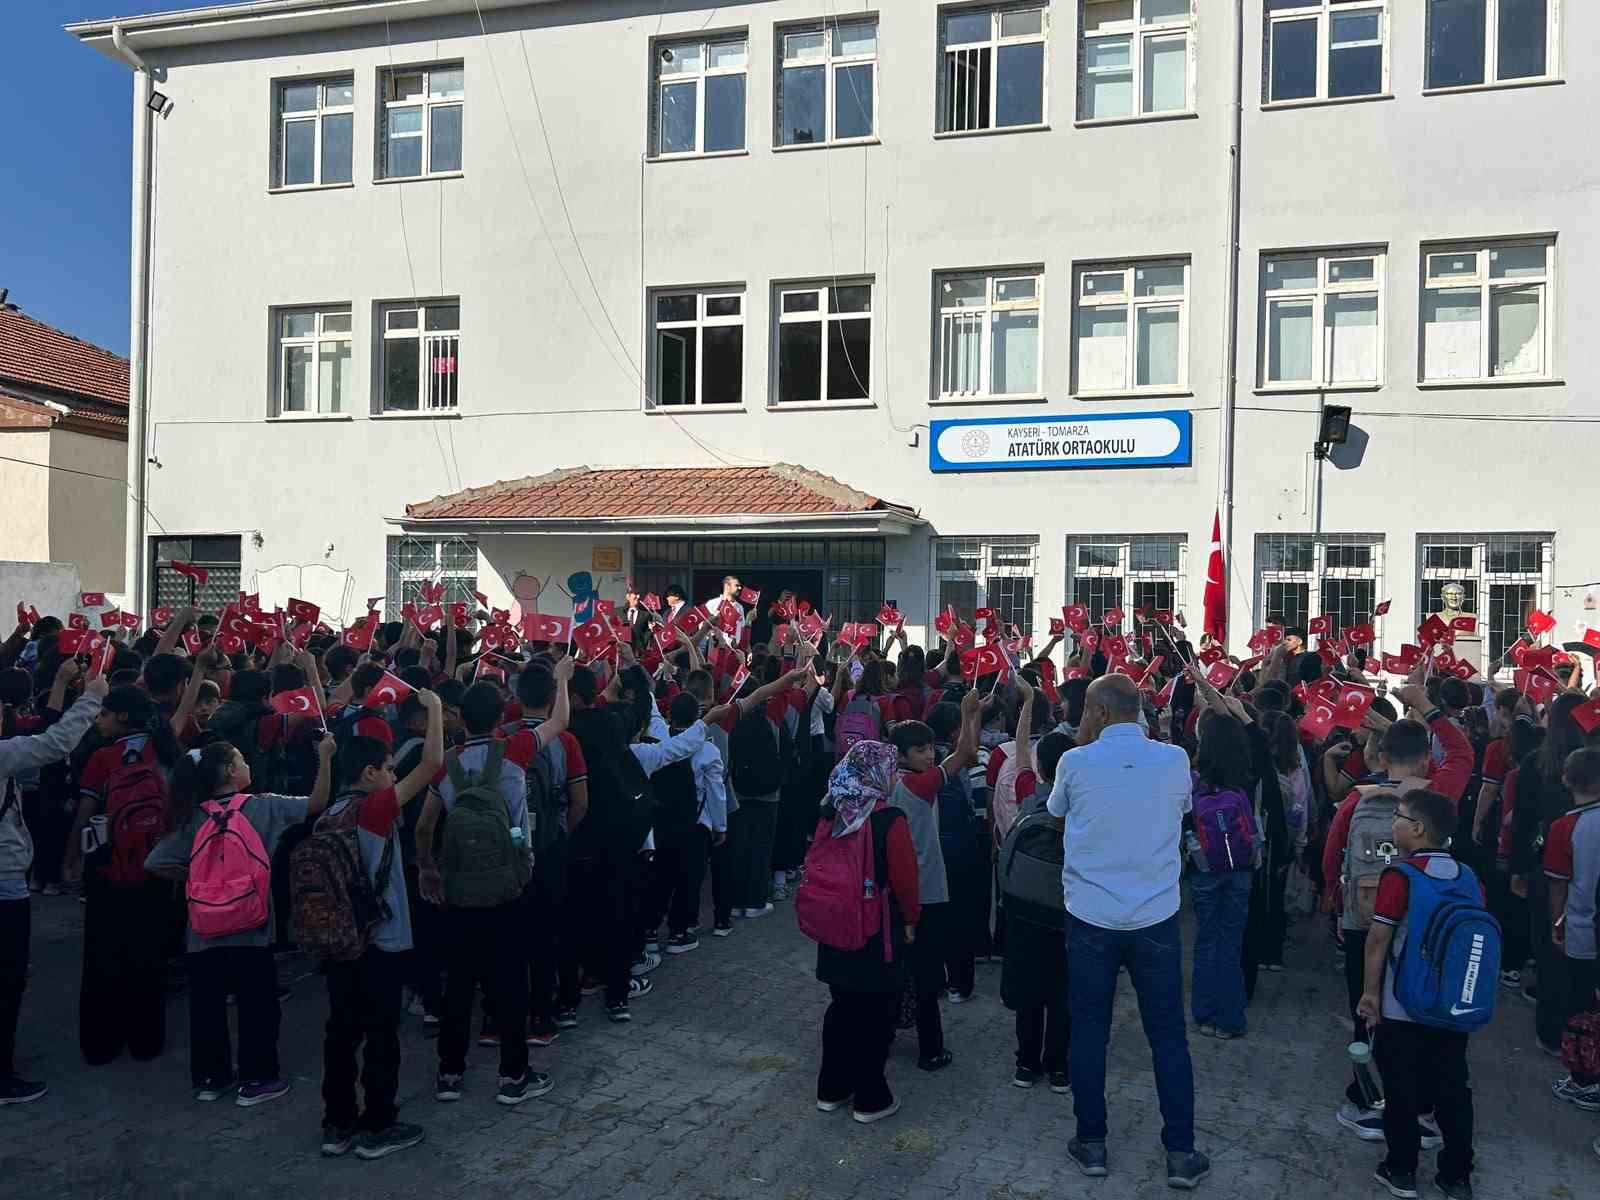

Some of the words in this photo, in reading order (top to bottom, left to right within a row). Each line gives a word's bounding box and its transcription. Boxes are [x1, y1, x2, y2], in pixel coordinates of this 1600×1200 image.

[1007, 425, 1041, 438] KAYSERİ
[1048, 425, 1090, 437] TOMARZA
[1008, 438, 1060, 457] ATATÜRK
[1062, 438, 1136, 455] ORTAOKULU
